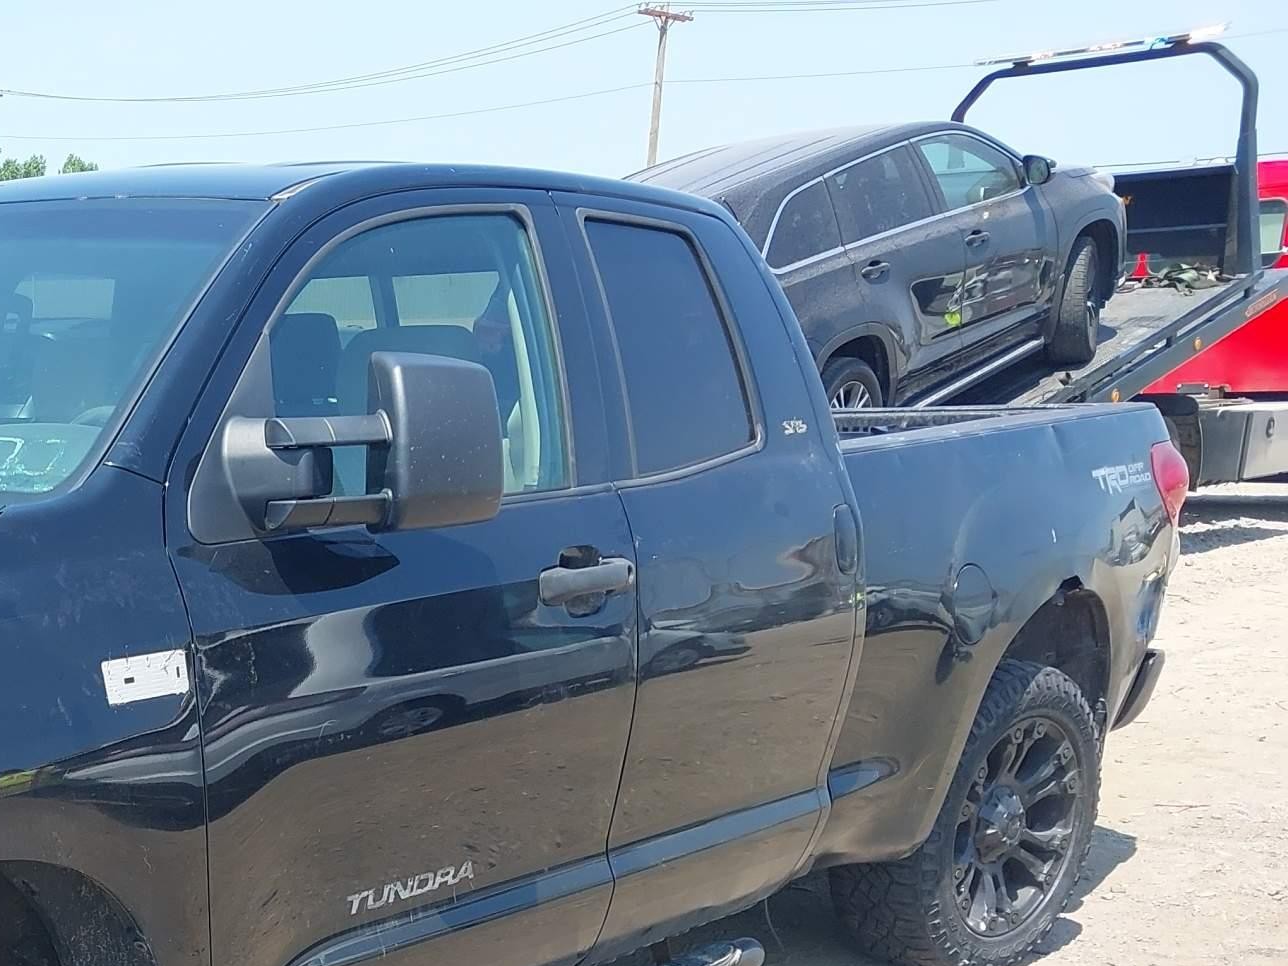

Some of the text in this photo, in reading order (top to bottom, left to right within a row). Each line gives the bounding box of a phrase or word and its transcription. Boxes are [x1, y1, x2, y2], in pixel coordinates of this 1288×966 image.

[1127, 462, 1145, 473] OFF
[1129, 471, 1153, 485] ROAD
[1091, 465, 1129, 496] TRD
[347, 859, 474, 915] TUNDRA
